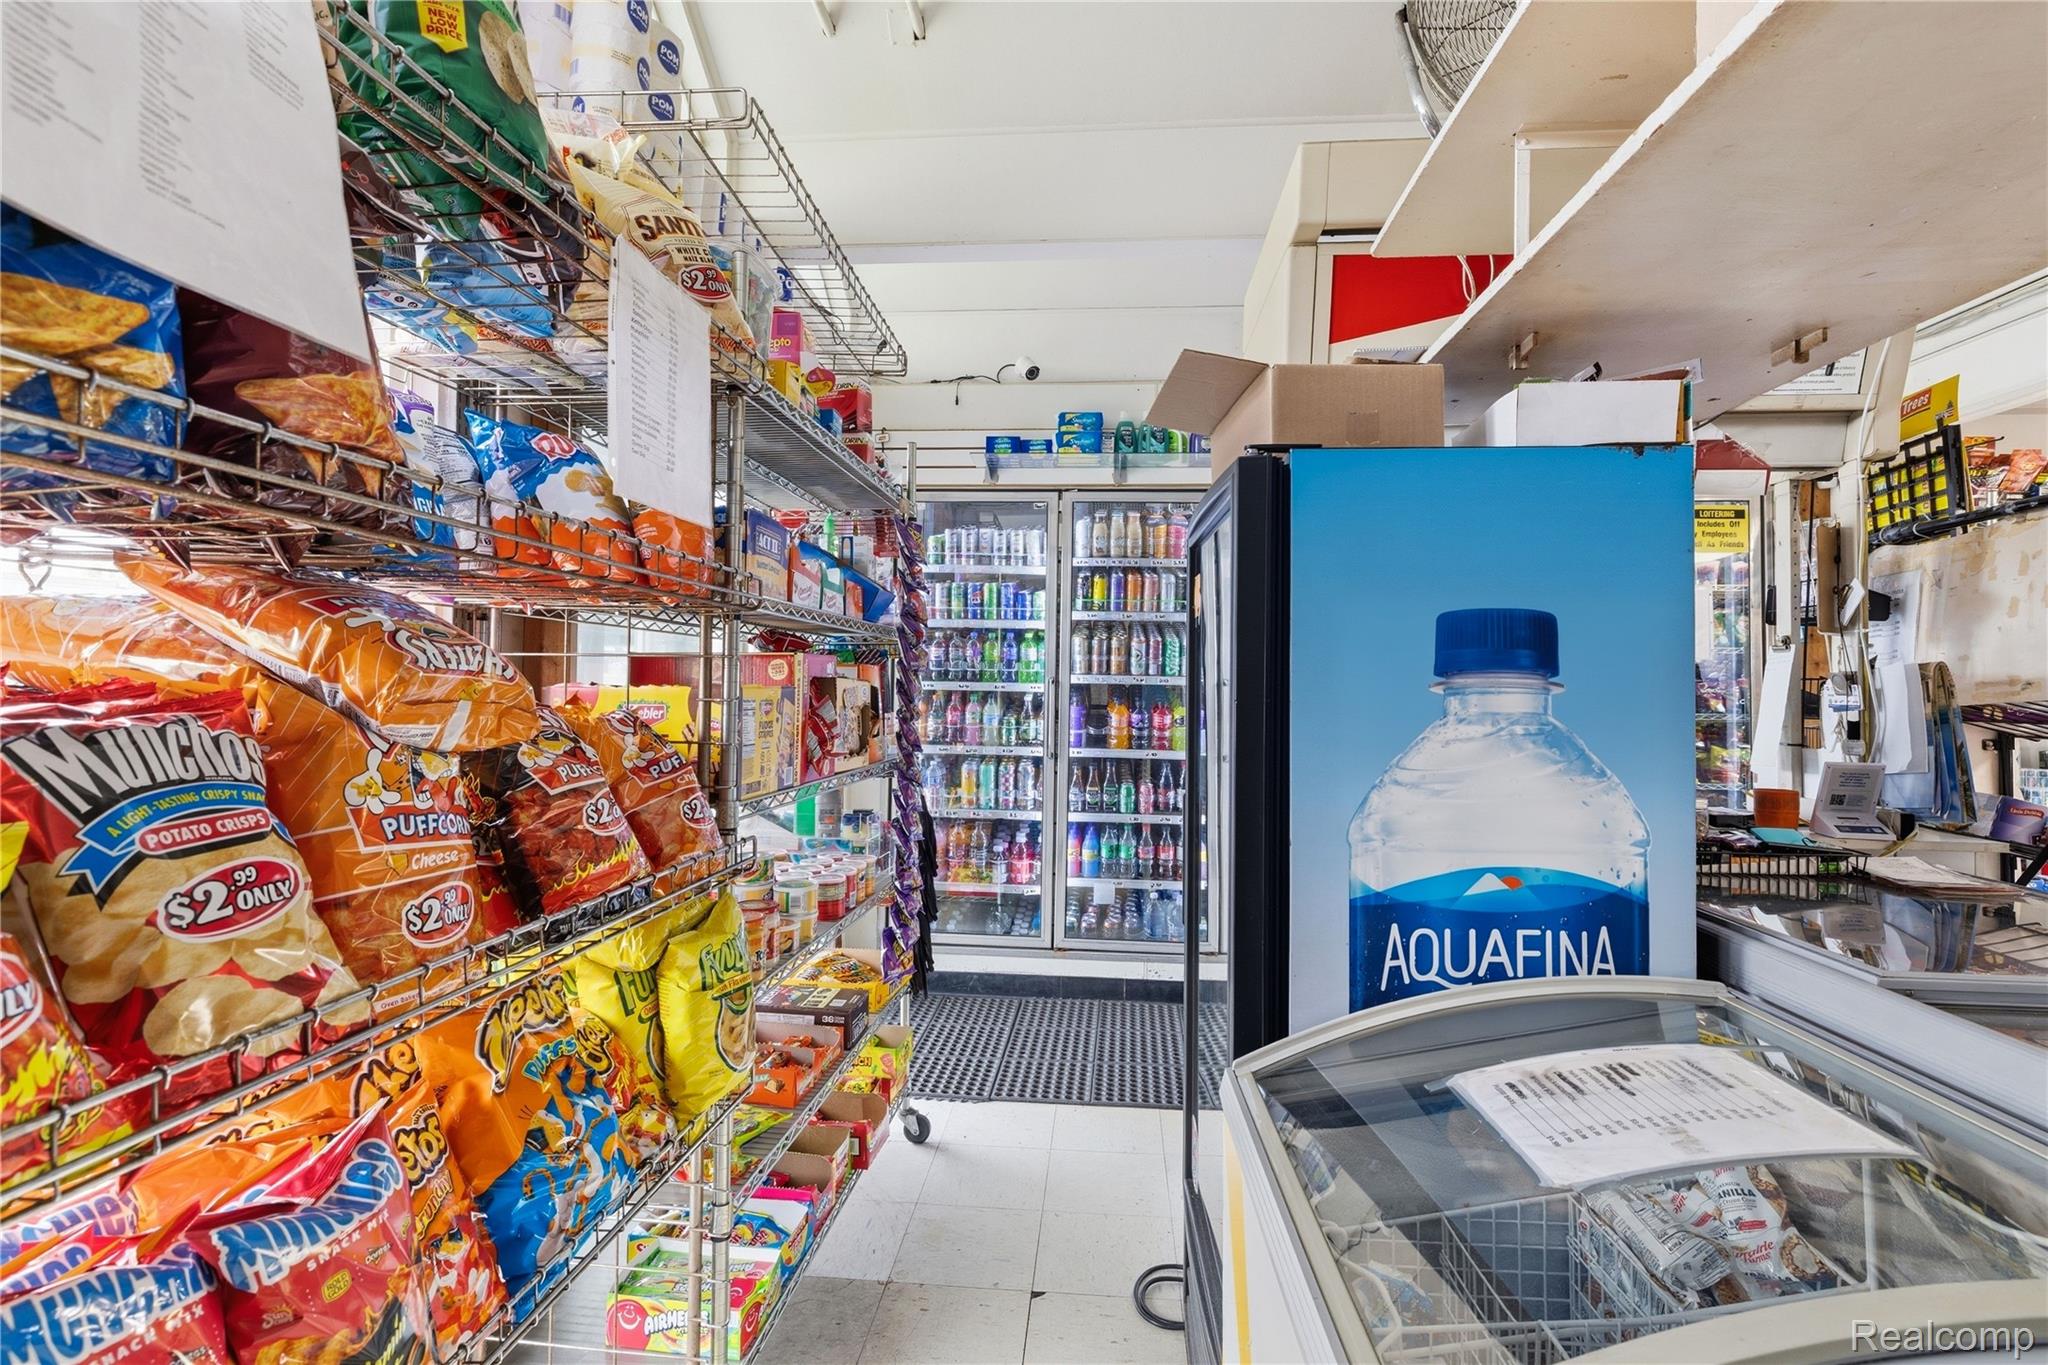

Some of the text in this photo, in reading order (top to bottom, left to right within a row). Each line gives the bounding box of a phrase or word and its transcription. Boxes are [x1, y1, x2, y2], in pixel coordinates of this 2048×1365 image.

[428, 7, 458, 22] NEW
[630, 1, 649, 23] POM
[426, 24, 463, 42] PRICE
[430, 16, 457, 30] LOW
[660, 44, 680, 66] POM
[651, 95, 674, 114] POM
[1903, 394, 1929, 415] Trees
[1696, 520, 1740, 528] Includes Off
[1699, 510, 1735, 518] LOITERING
[1701, 530, 1737, 539] Employees
[638, 706, 664, 719] ebler
[106, 825, 122, 838] A
[201, 789, 239, 801] CRISPY
[242, 790, 266, 802] SNA
[144, 812, 267, 849] POTATO CRISPS
[411, 849, 460, 870] Cheese
[236, 878, 294, 912] ONLY
[1380, 922, 1617, 990] AQUAFINA
[306, 1209, 391, 1273] SNACK MIX
[262, 1310, 289, 1330] Sun
